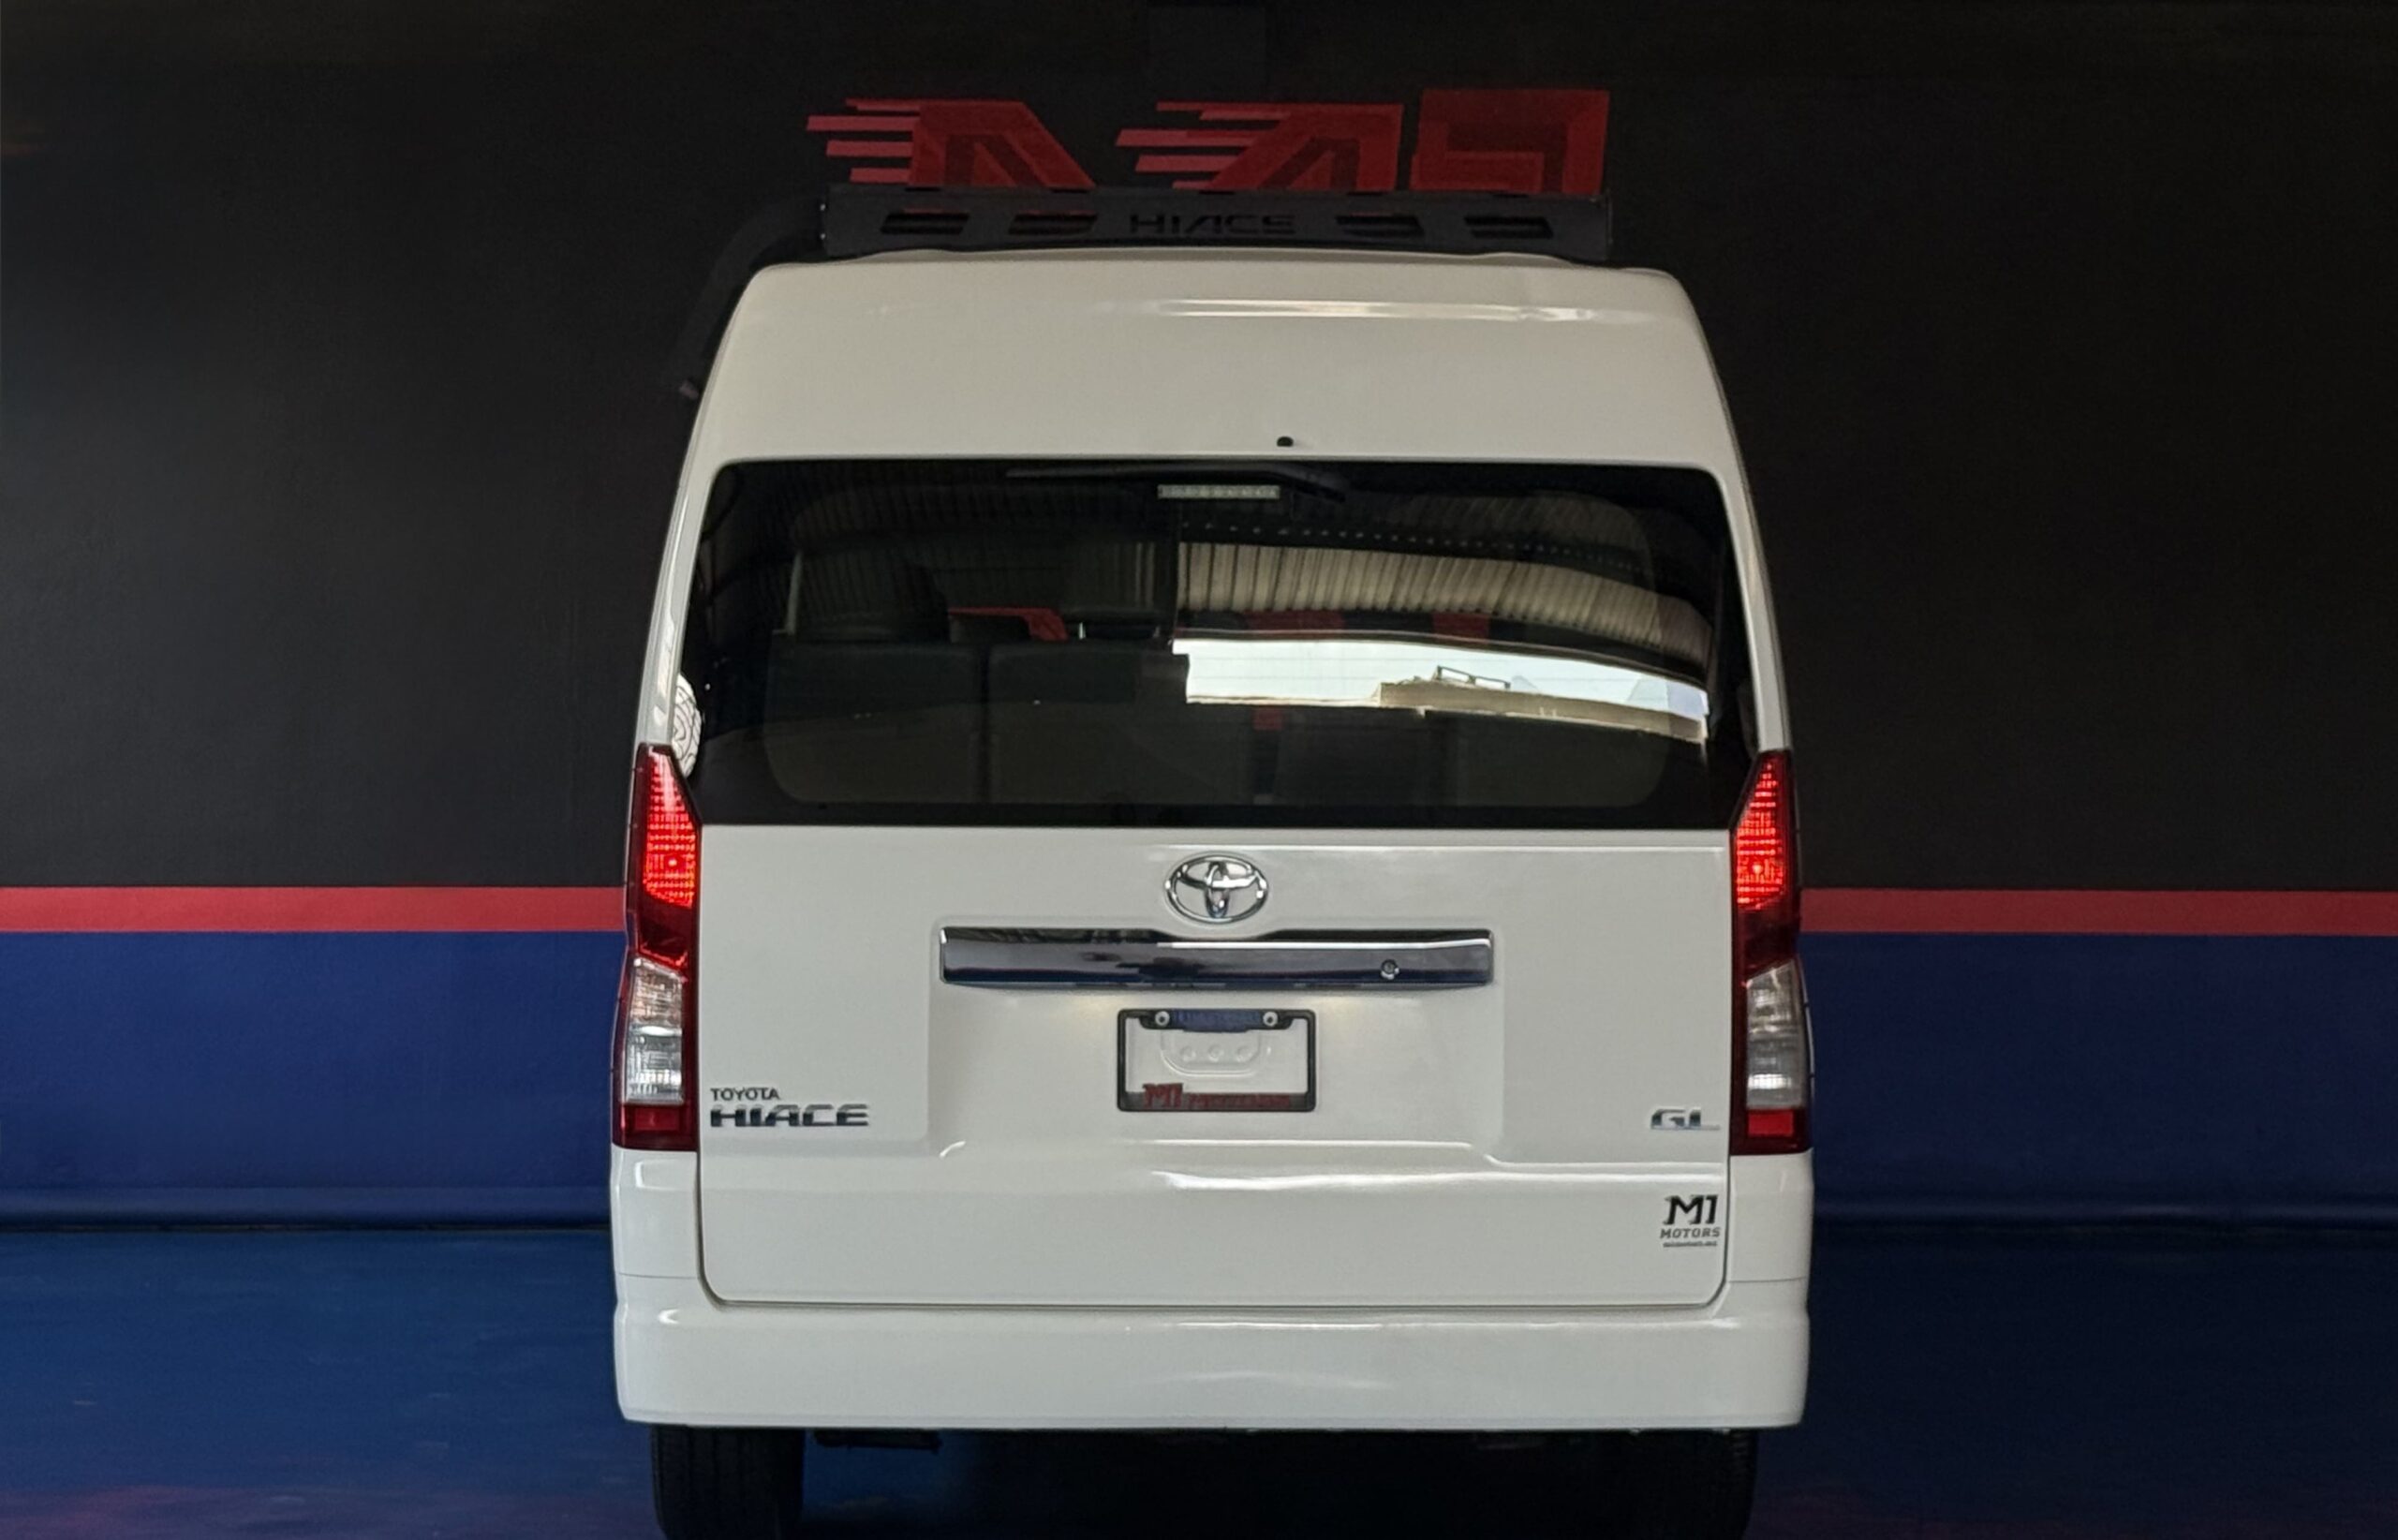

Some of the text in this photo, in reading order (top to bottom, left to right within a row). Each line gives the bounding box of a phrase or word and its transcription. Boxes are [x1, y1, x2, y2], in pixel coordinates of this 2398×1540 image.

[1130, 214, 1296, 234] HIACE
[710, 1087, 780, 1102] TOYOTA
[710, 1103, 869, 1128] HIACE
[1650, 1108, 1722, 1132] GL
[1663, 1193, 1719, 1225] M1
[1660, 1227, 1721, 1239] MOTORS
